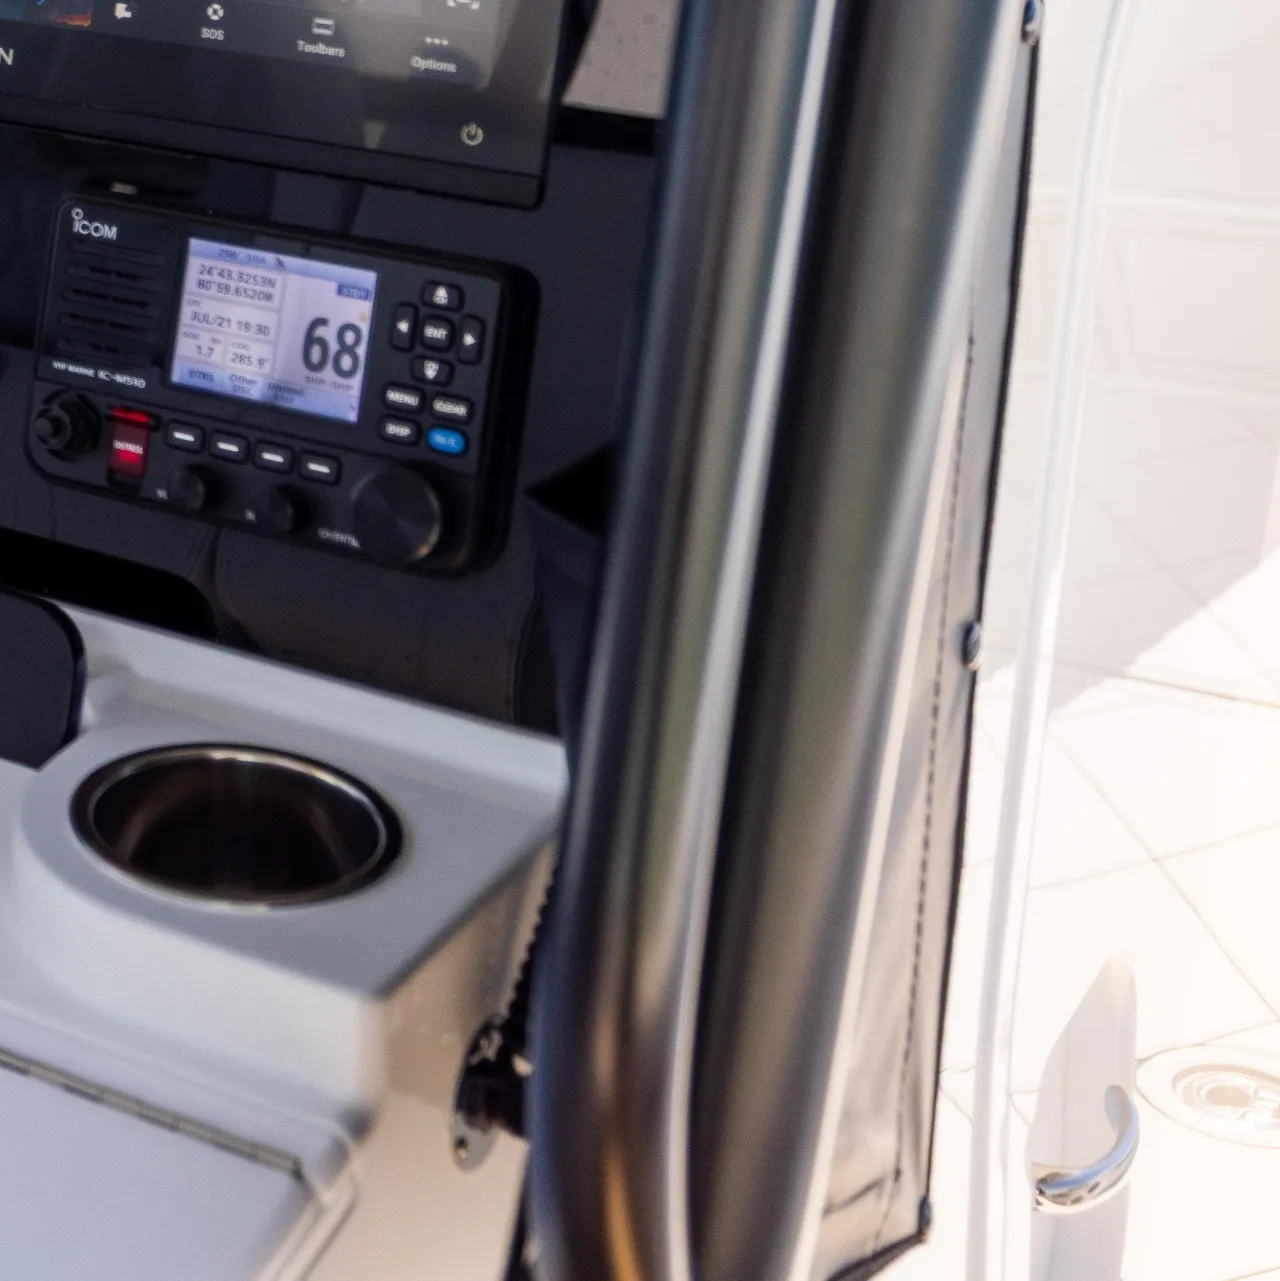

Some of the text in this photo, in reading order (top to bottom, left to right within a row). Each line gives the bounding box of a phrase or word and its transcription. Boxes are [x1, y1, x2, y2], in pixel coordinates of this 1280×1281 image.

[200, 27, 225, 41] SOS
[296, 40, 346, 58] Toolbars
[410, 56, 457, 74] Options
[72, 208, 118, 240] ICOM
[302, 316, 363, 380] 68
[386, 390, 419, 406] MENU
